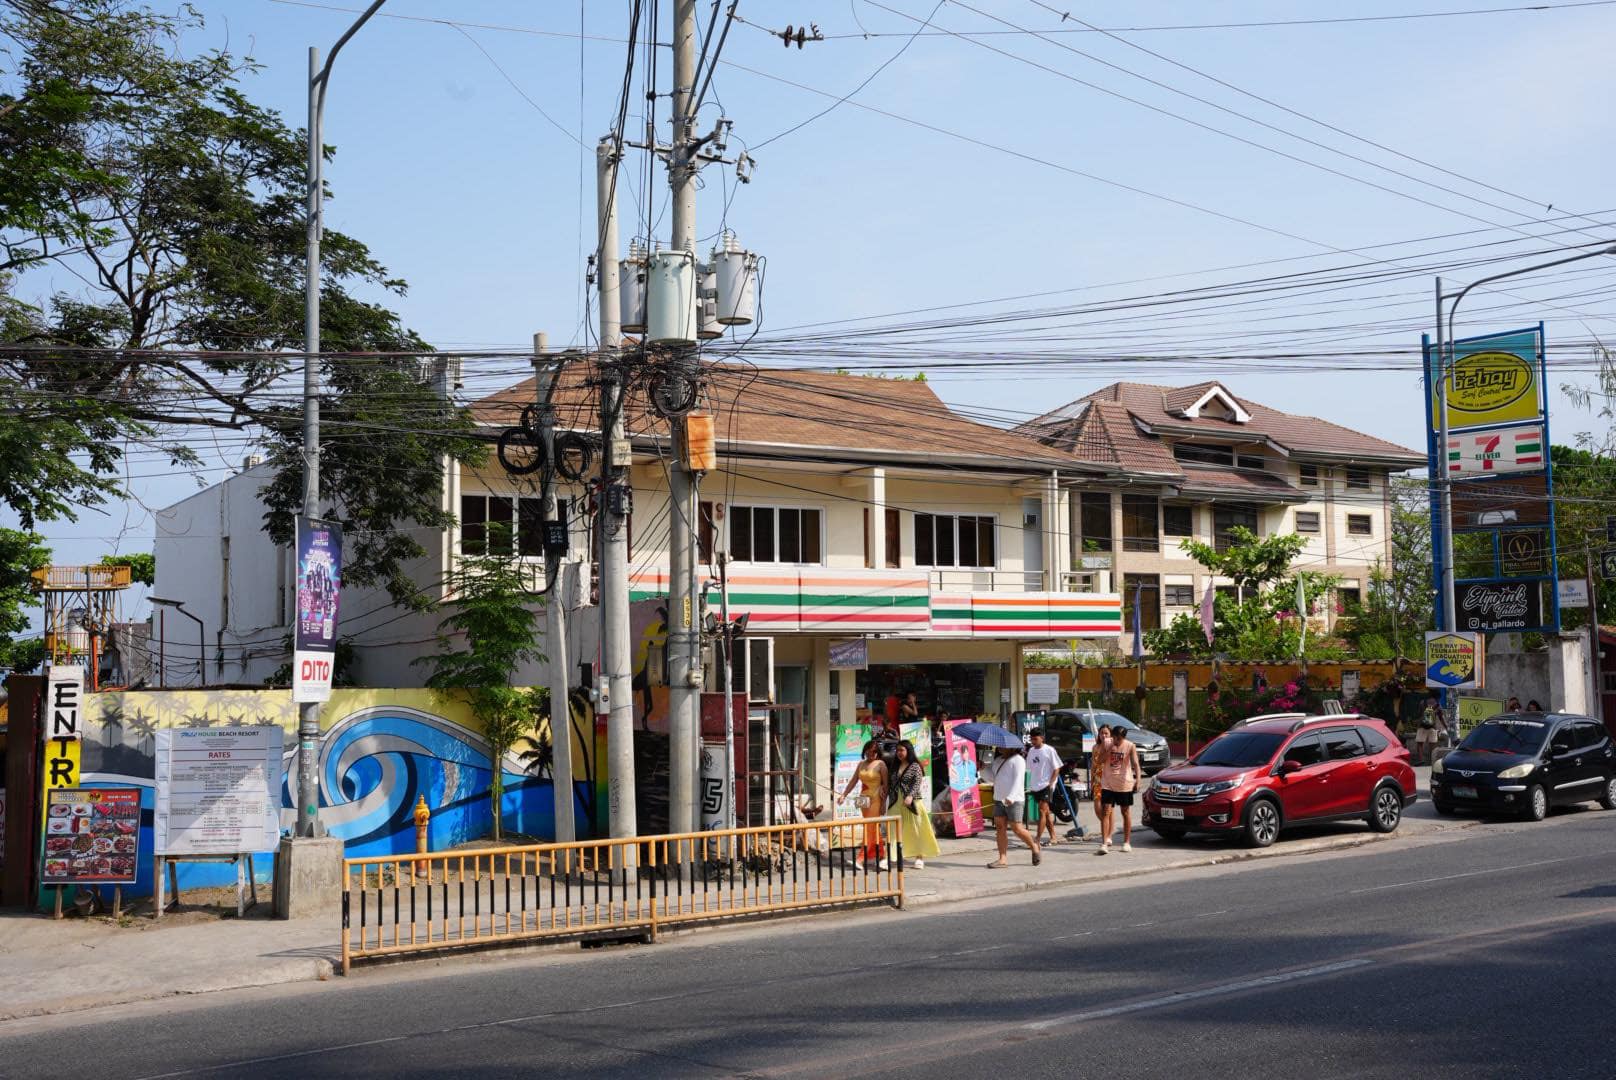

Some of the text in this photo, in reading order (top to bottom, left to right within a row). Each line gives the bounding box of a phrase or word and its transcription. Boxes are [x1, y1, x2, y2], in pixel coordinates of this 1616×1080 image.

[1475, 435, 1500, 470] 7
[1481, 620, 1525, 630] ej_gallardo
[301, 660, 329, 681] DITO
[50, 682, 80, 788] ENTR
